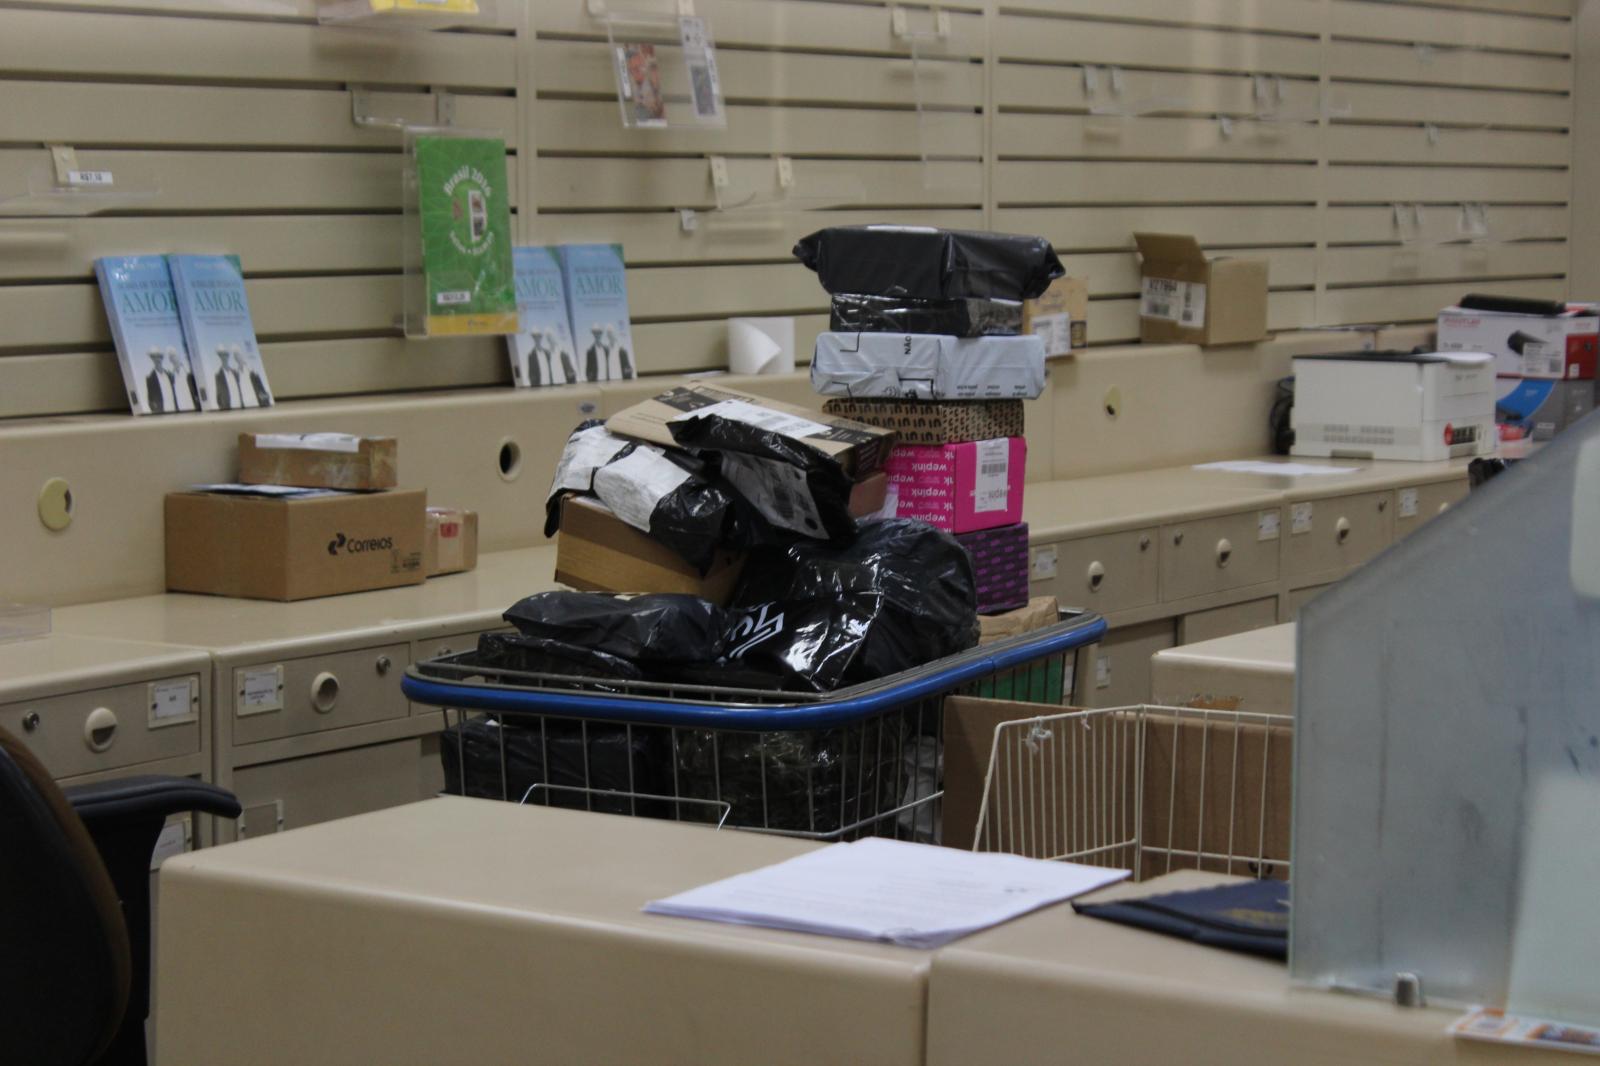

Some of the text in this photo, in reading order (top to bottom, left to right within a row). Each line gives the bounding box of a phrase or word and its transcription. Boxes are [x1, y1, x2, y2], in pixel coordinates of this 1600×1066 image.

[443, 165, 469, 196] Brasil
[575, 273, 623, 295] AMOR
[194, 289, 245, 313] AMOR
[911, 461, 947, 472] wepink
[911, 487, 947, 497] wepink
[346, 536, 393, 553] Correios
